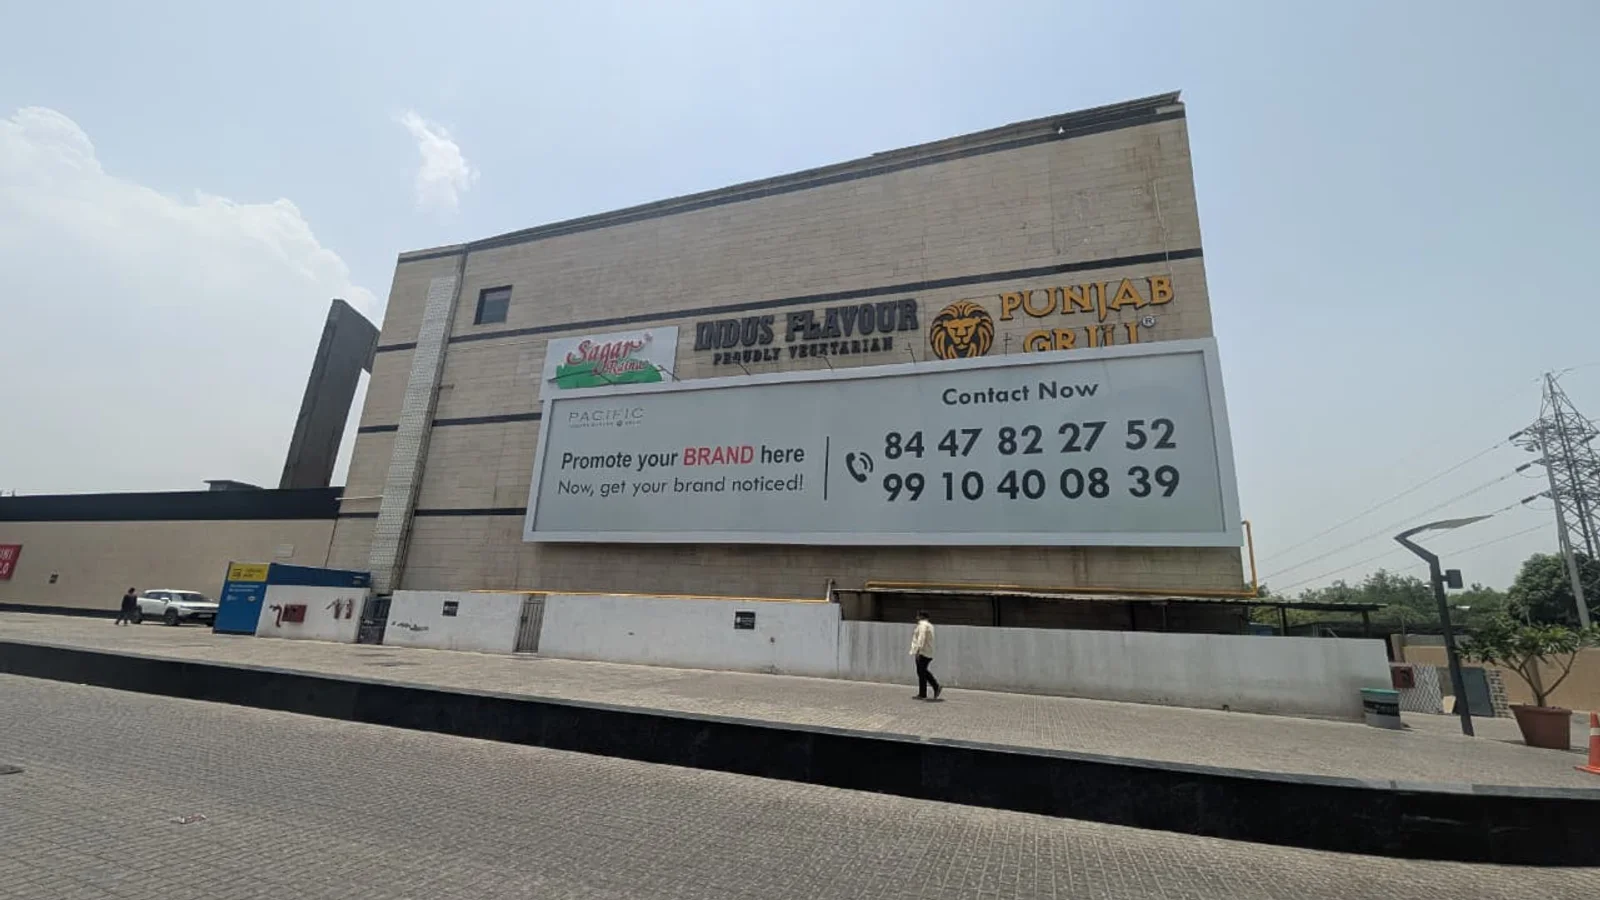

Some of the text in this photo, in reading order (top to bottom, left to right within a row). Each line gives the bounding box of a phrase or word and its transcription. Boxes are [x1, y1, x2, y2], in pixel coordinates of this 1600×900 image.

[999, 275, 1174, 322] PUNJAB
[694, 299, 919, 351] INDUS FLAVOUR
[566, 339, 643, 373] Sagar
[713, 336, 893, 366] PROUDLY VEGETARIAN
[942, 381, 1099, 405] Contact Now
[569, 407, 644, 423] PACIFIC
[884, 418, 1176, 460] 84 47 82 27 52
[561, 444, 805, 471] Promote your BRAND here
[558, 474, 804, 497] Now, get your brand noticed!
[883, 465, 1180, 501] 99 10 40 08 39
